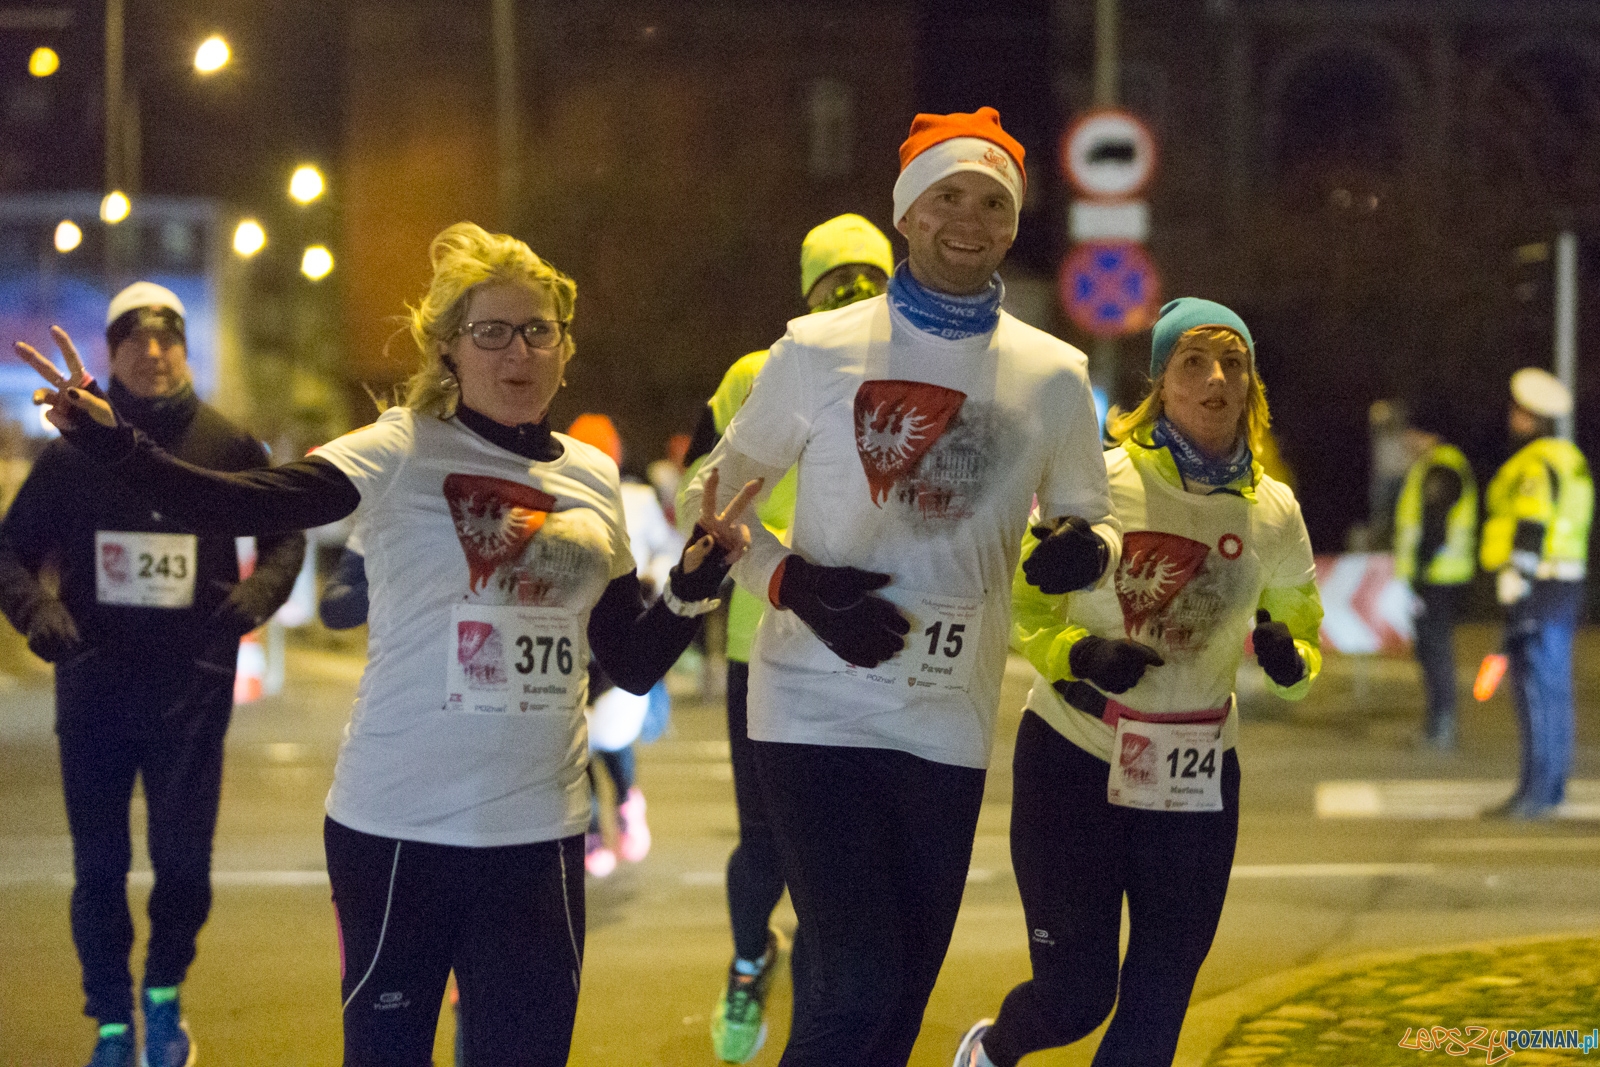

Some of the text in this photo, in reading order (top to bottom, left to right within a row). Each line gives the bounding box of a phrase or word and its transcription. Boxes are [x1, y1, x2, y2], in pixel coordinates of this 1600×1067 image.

[138, 552, 187, 580] 243
[514, 635, 573, 675] 376
[925, 621, 966, 658] 15
[1166, 747, 1216, 779] 124
